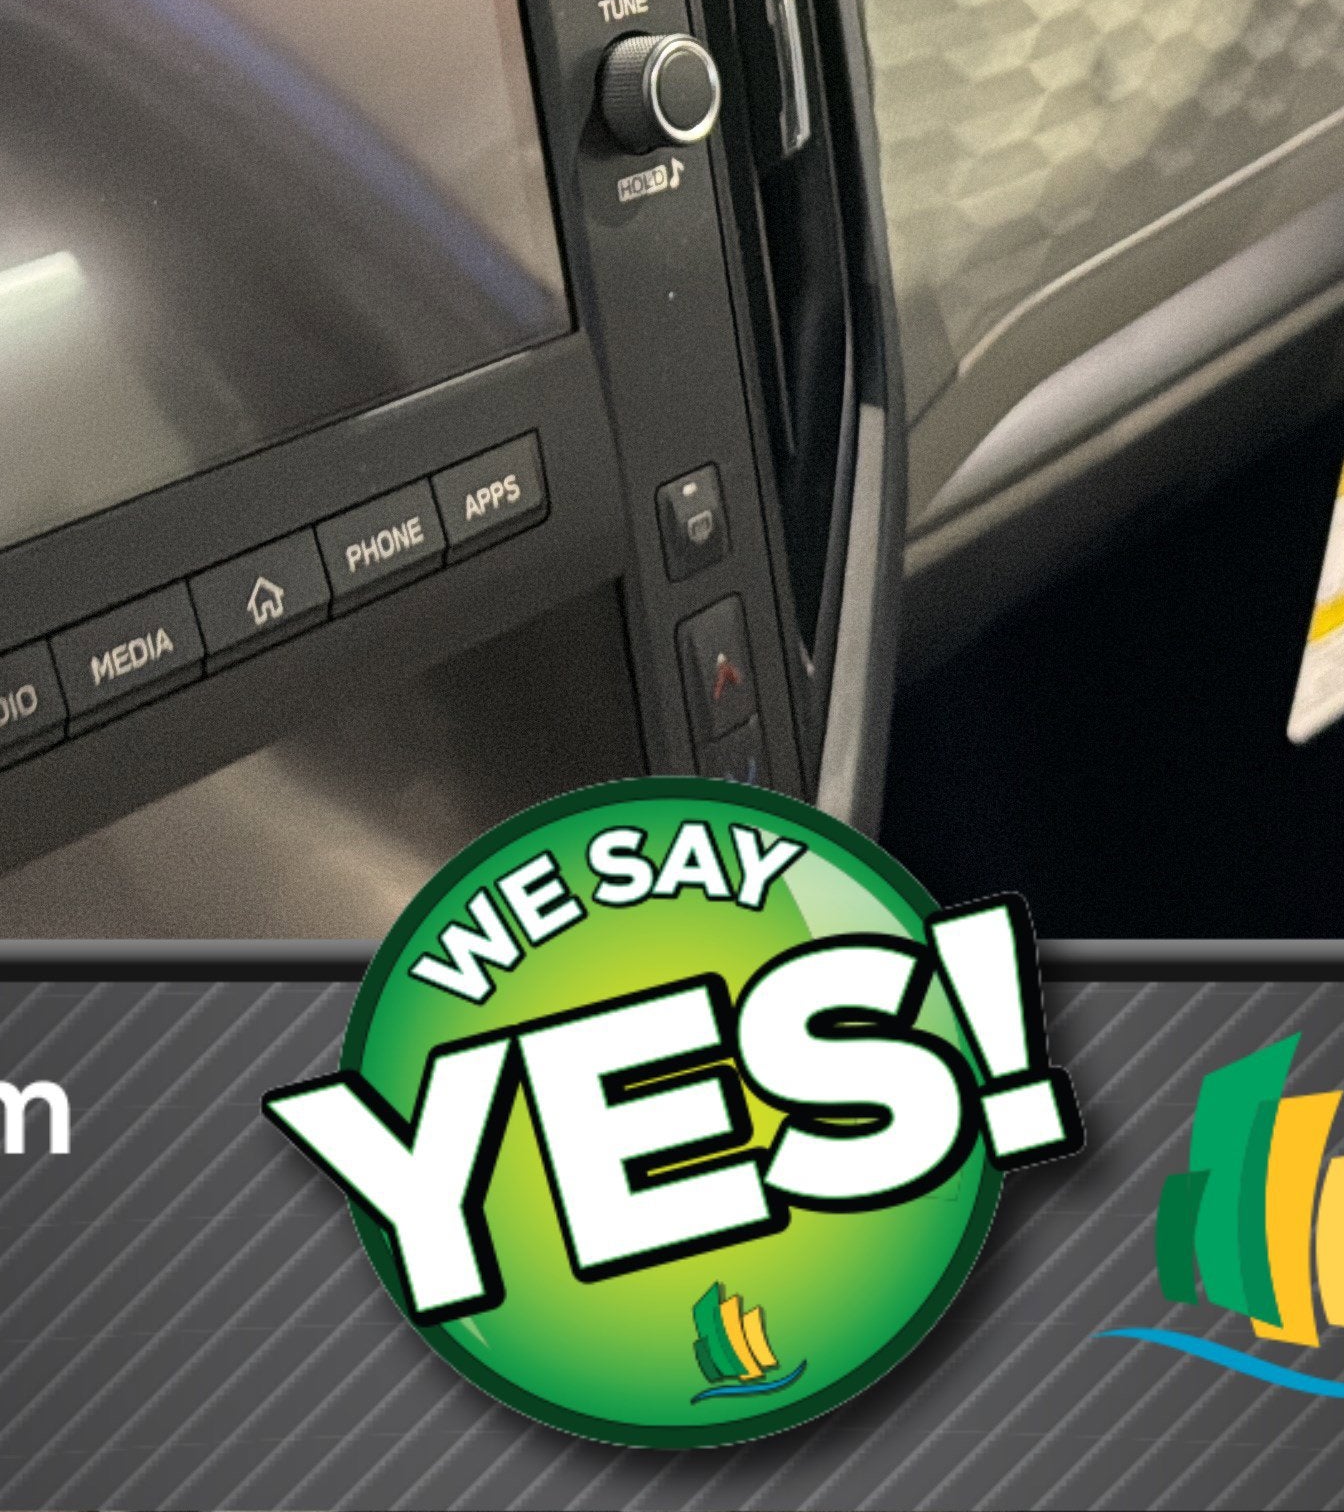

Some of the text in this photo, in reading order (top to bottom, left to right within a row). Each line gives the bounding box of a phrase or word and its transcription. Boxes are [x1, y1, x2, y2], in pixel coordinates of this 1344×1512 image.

[619, 167, 666, 199] HOLD
[465, 474, 521, 521] APPS
[345, 516, 425, 574] PHONE
[90, 627, 175, 686] MEDIA
